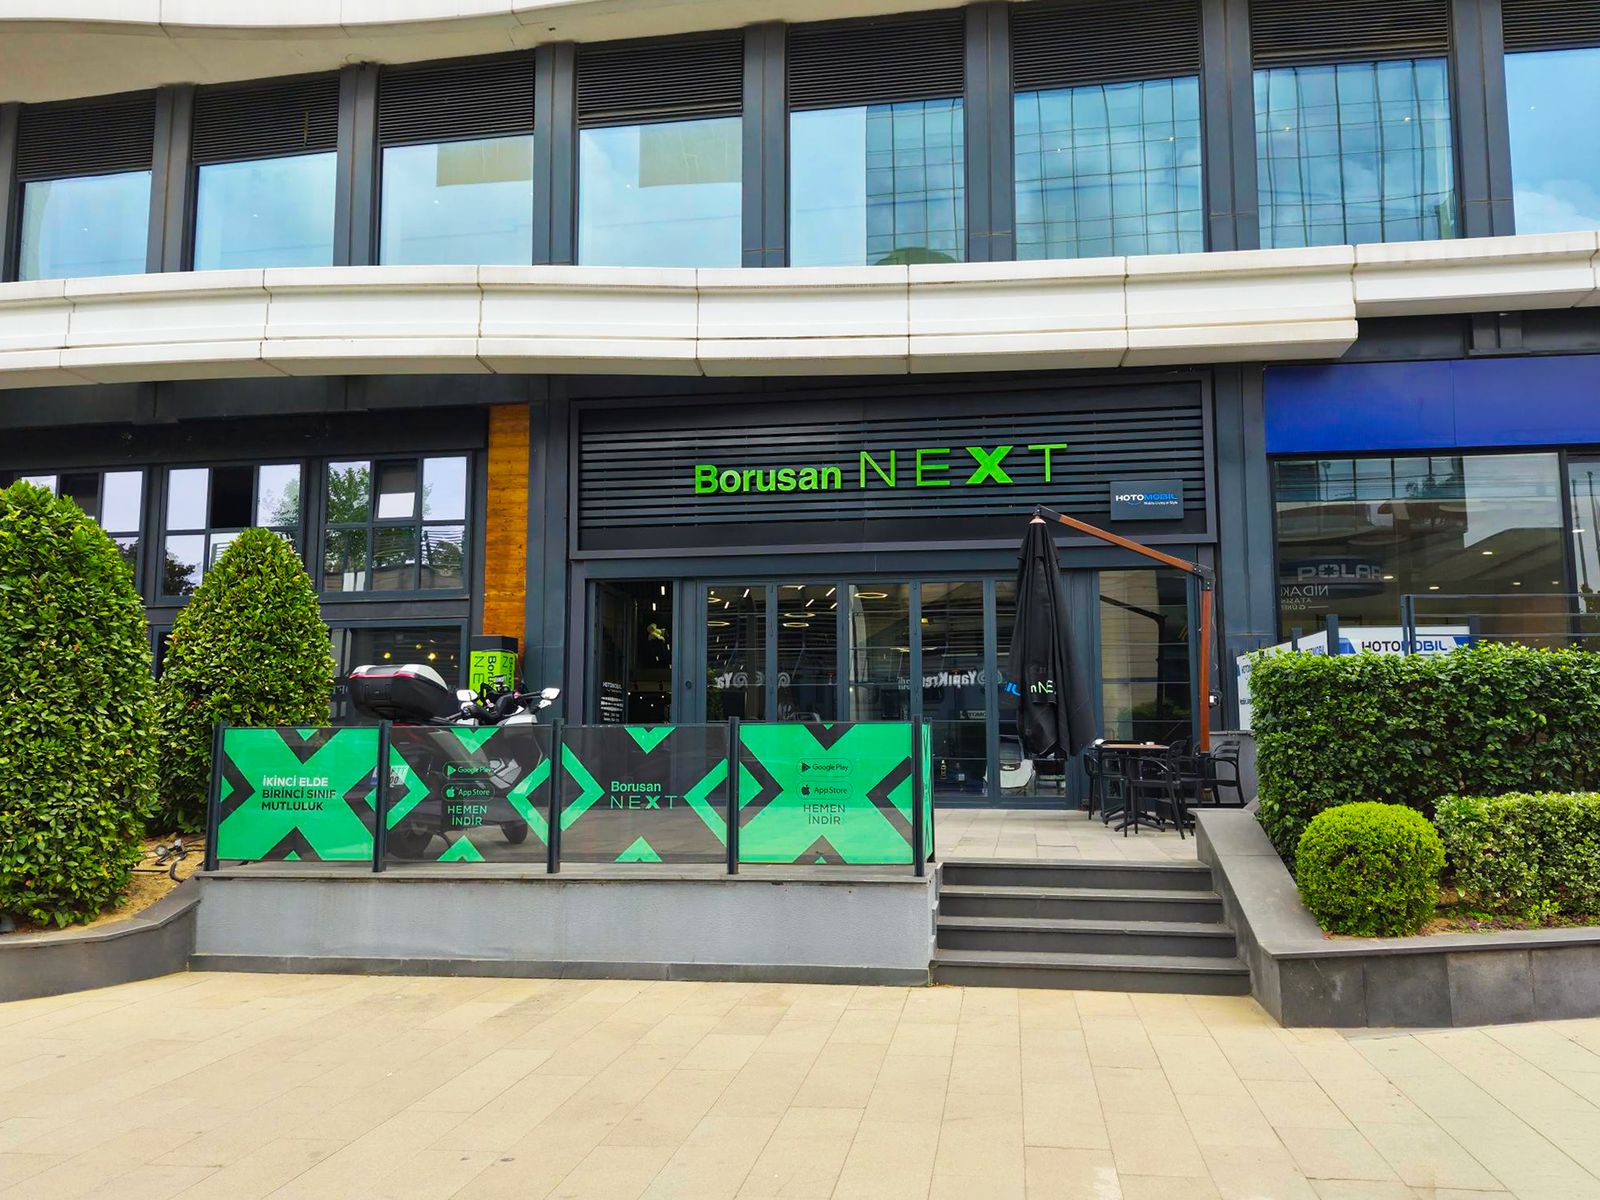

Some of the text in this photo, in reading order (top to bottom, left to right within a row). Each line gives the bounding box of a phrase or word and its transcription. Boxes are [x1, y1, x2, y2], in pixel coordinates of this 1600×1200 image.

[695, 443, 1068, 494] Borusan NEXT
[1115, 493, 1178, 502] HOTOMOBIL
[812, 763, 849, 772] Google Play
[262, 775, 328, 787] İKİNCİ ELDE
[611, 781, 661, 792] Borusan
[814, 787, 828, 795] App
[262, 787, 336, 799] BİRİNCİ SINIF
[458, 788, 490, 797] App Store
[261, 801, 324, 811] MUTLULUK
[610, 795, 678, 809] NEXT
[447, 805, 488, 814] HEMEN
[803, 804, 846, 813] HEMEN
[451, 815, 483, 826] İNDİR
[808, 813, 841, 825] İNDİR
